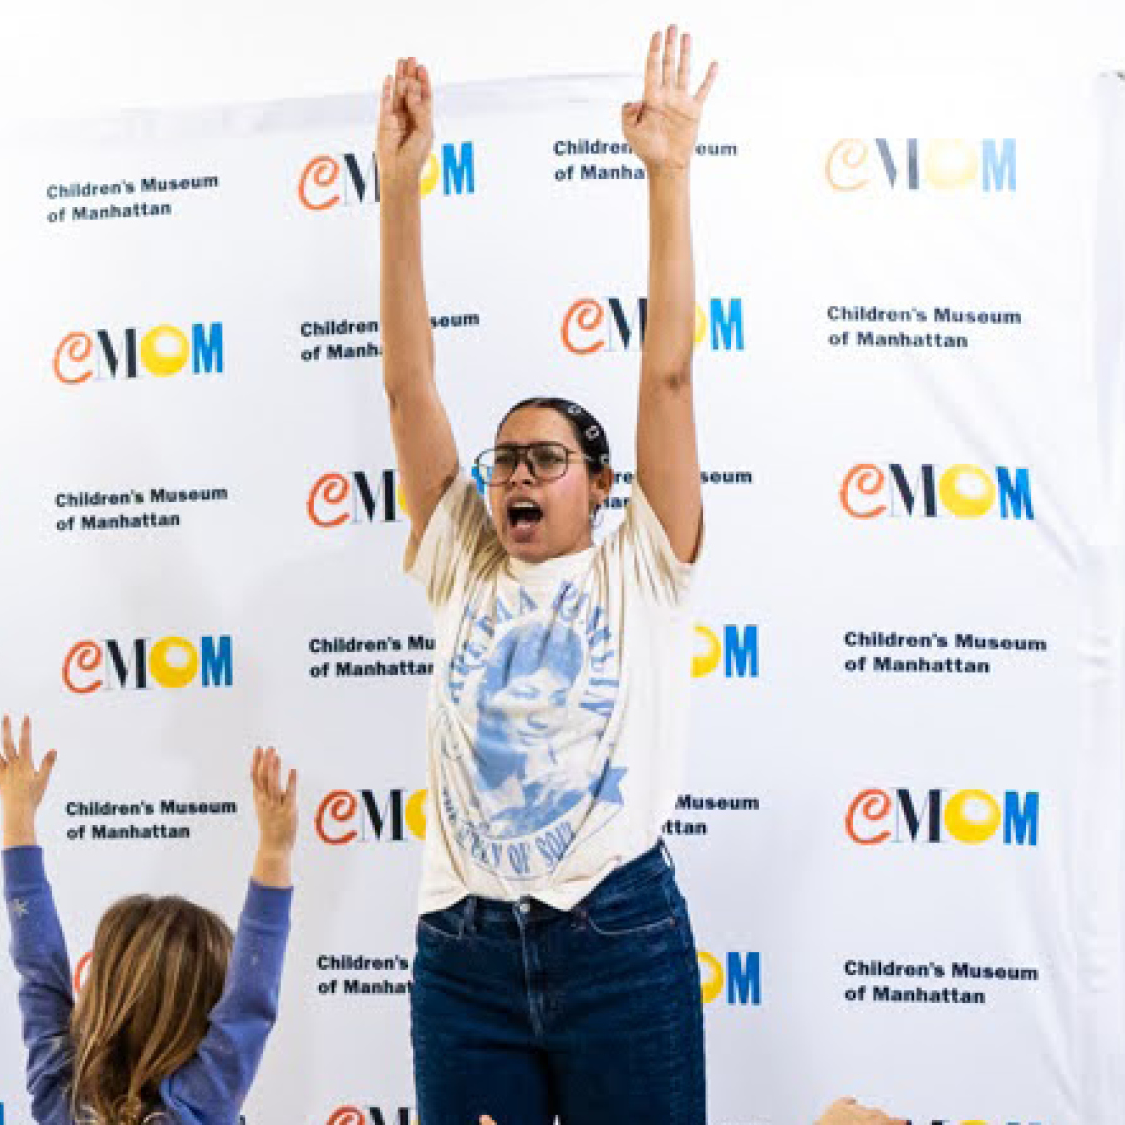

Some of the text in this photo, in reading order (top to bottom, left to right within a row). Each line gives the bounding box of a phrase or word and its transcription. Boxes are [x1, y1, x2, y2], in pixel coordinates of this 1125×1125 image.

[553, 138, 632, 156] Children
[555, 165, 645, 181] of Manha
[825, 138, 1016, 192] CMOM
[298, 140, 475, 213] CMM
[47, 176, 218, 199] Children's Museum
[47, 202, 171, 222] of Manhattan
[828, 306, 1021, 324] Children's Museum
[301, 312, 481, 337] Children seum
[560, 297, 746, 355] CMM
[828, 332, 968, 347] of Manhattan
[52, 321, 225, 385] CMOM
[301, 347, 321, 362] of
[701, 472, 752, 484] seum
[55, 489, 227, 507] Children's Museum
[838, 464, 1036, 520] CMOM
[57, 513, 179, 530] of Manhattan
[309, 637, 401, 652] Children's
[845, 632, 1046, 650] Children's Museum
[62, 634, 233, 695] CMOM
[309, 662, 329, 677] of
[845, 657, 990, 673] of Manhattan
[67, 800, 237, 815] Children's Museum
[843, 787, 1039, 846] CMOM
[67, 825, 189, 840] of Manhattan
[317, 955, 408, 970] Children's
[845, 960, 1038, 980] Children's Museum
[319, 980, 337, 993] of
[845, 985, 985, 1003] of Manhattan
